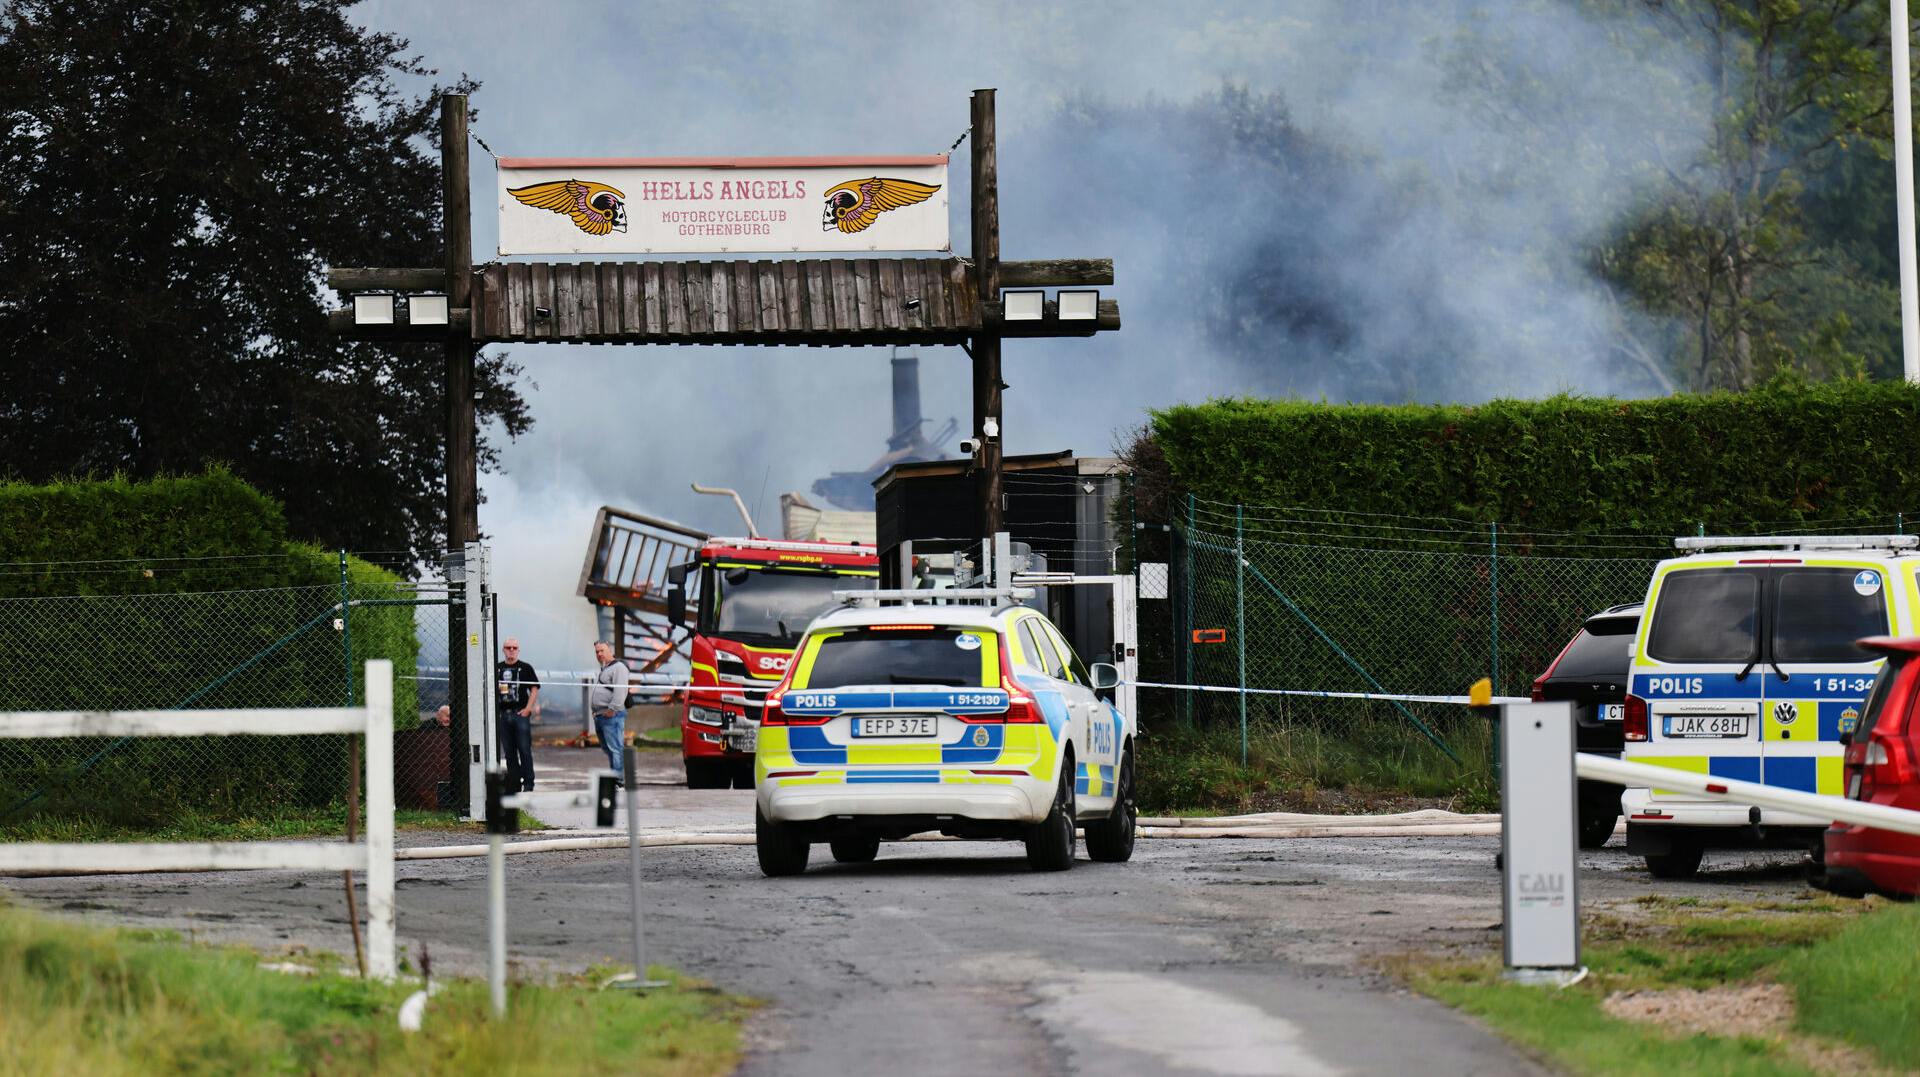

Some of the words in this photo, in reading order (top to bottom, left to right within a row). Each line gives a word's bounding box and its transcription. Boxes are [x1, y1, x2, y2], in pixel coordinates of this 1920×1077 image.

[643, 181, 714, 200] HELLS
[720, 180, 806, 200] ANGELS
[662, 210, 787, 223] MOTORCYCLECLUB
[679, 224, 771, 236] GOTHENBURG
[1649, 677, 1703, 694] POLIS
[1813, 679, 1821, 691] 1
[795, 694, 837, 708] POLIS
[949, 695, 954, 705] 1
[958, 695, 1000, 705] 51-2130
[865, 719, 895, 733] EFP
[900, 719, 930, 733] 37E
[1676, 718, 1705, 733] JAK
[1710, 718, 1741, 733] 68H
[1094, 721, 1111, 754] POLIS
